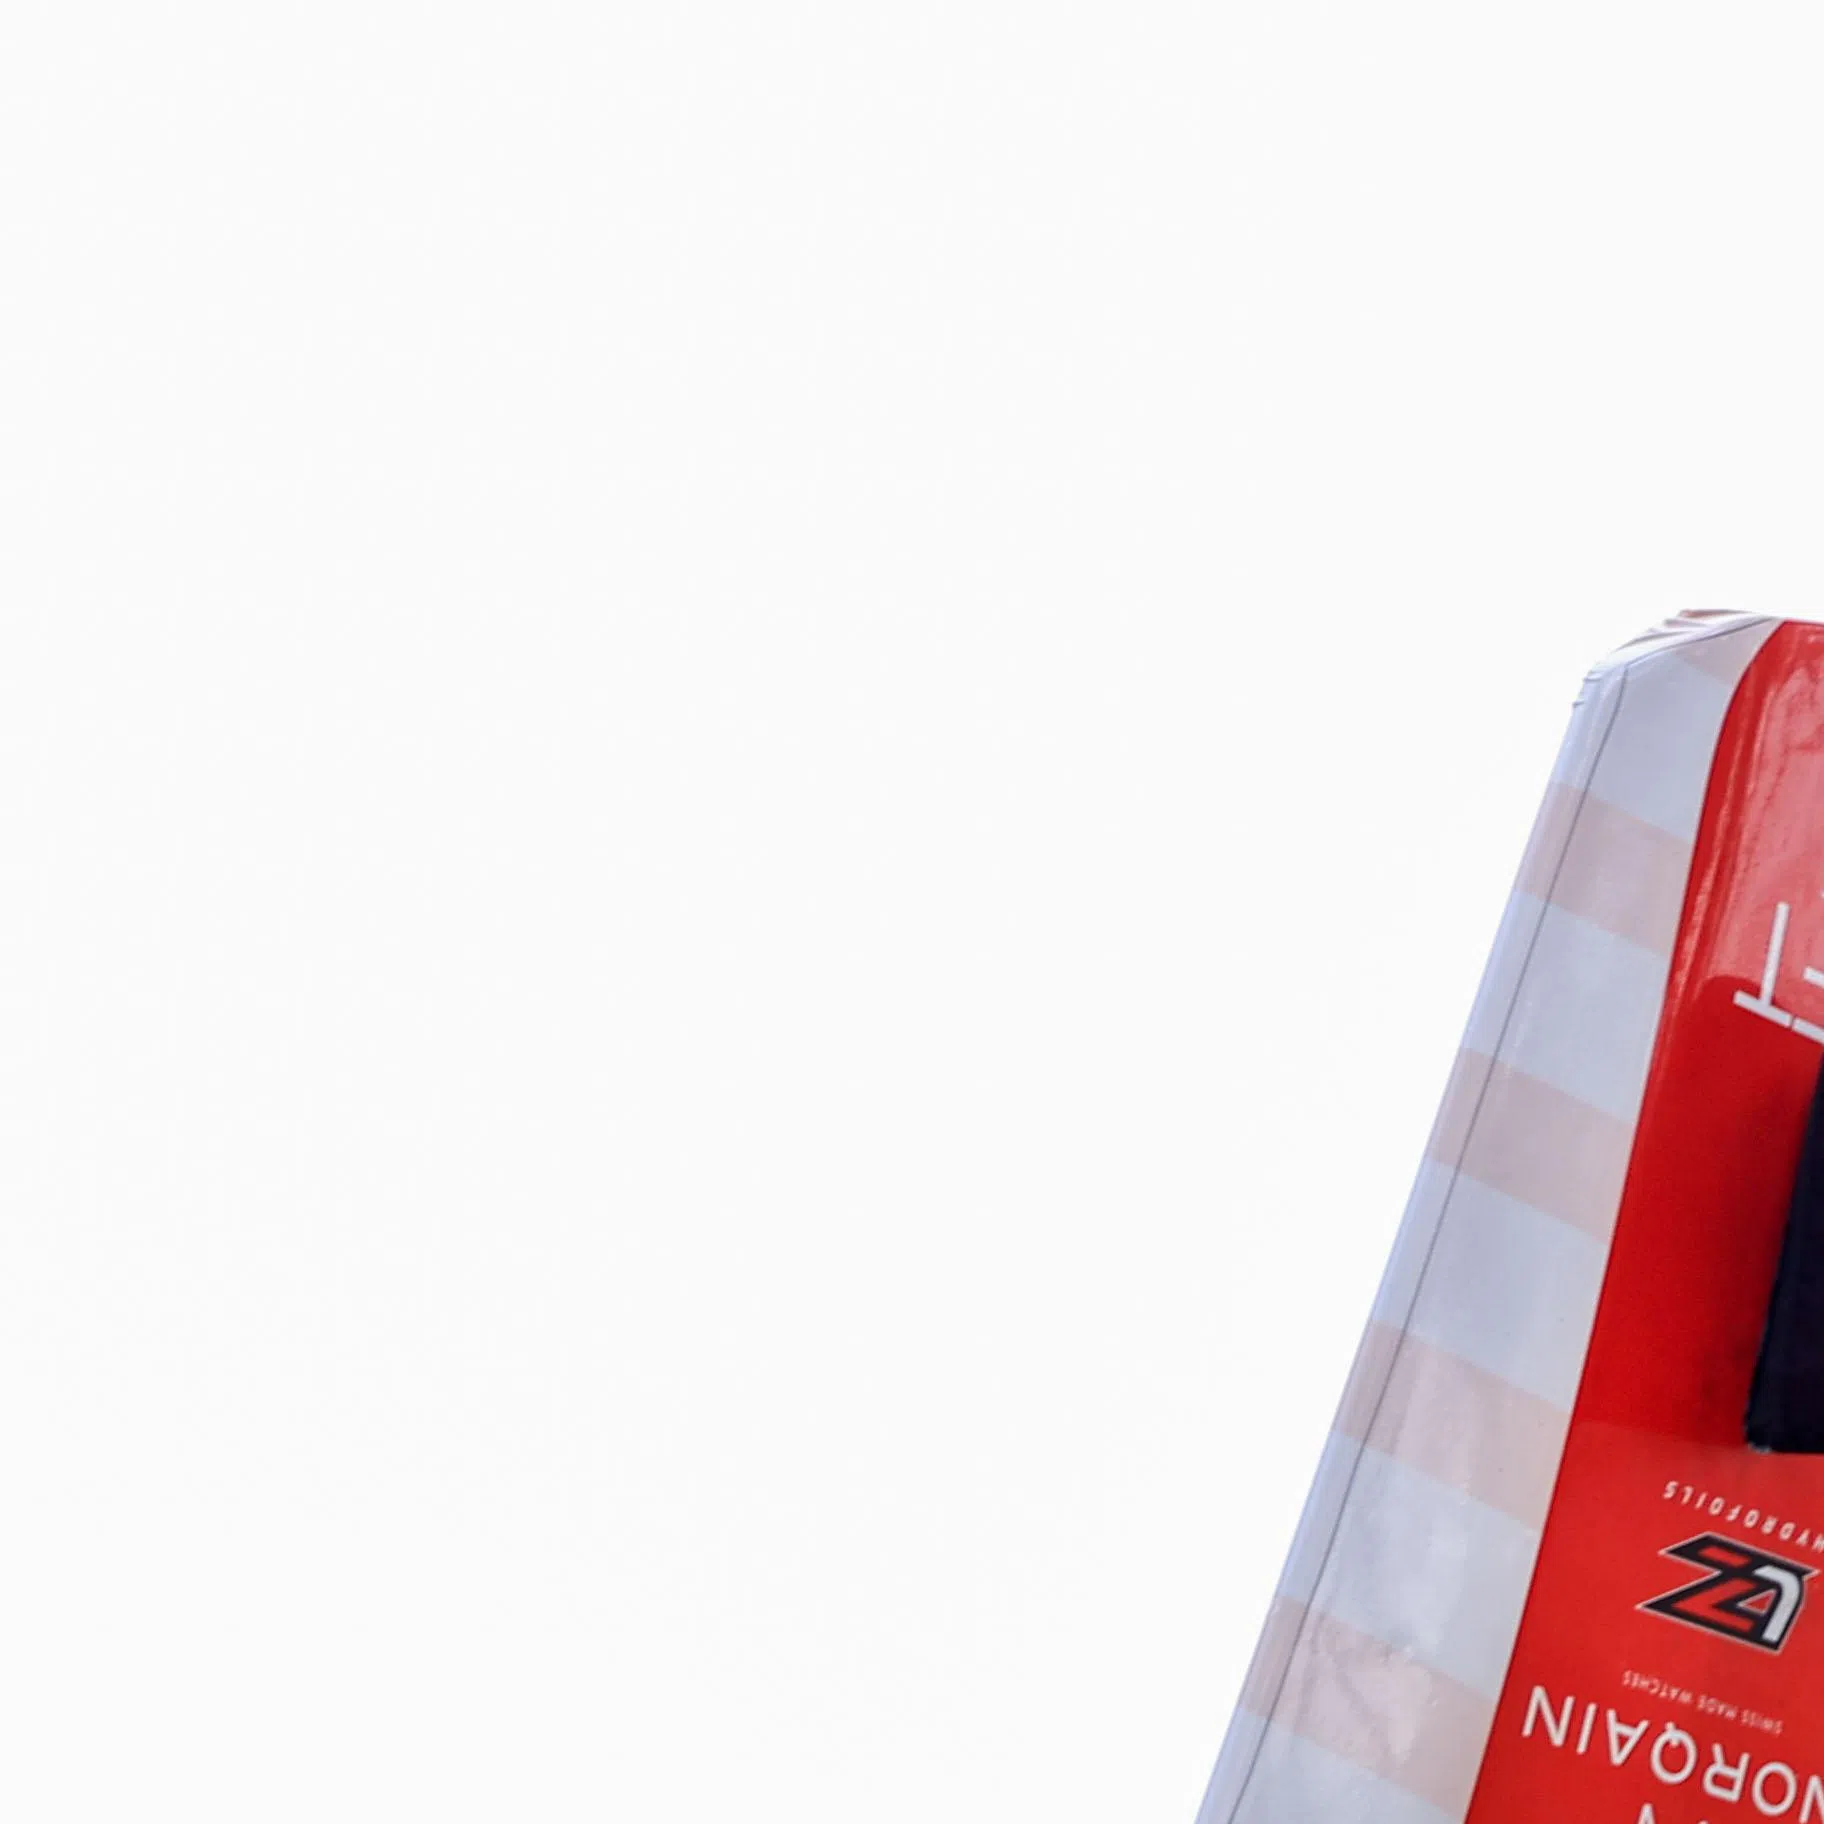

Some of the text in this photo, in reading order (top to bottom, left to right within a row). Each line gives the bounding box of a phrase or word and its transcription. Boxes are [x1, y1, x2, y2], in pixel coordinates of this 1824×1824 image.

[1621, 1669, 1784, 1736] SWISS MADE WATCHES
